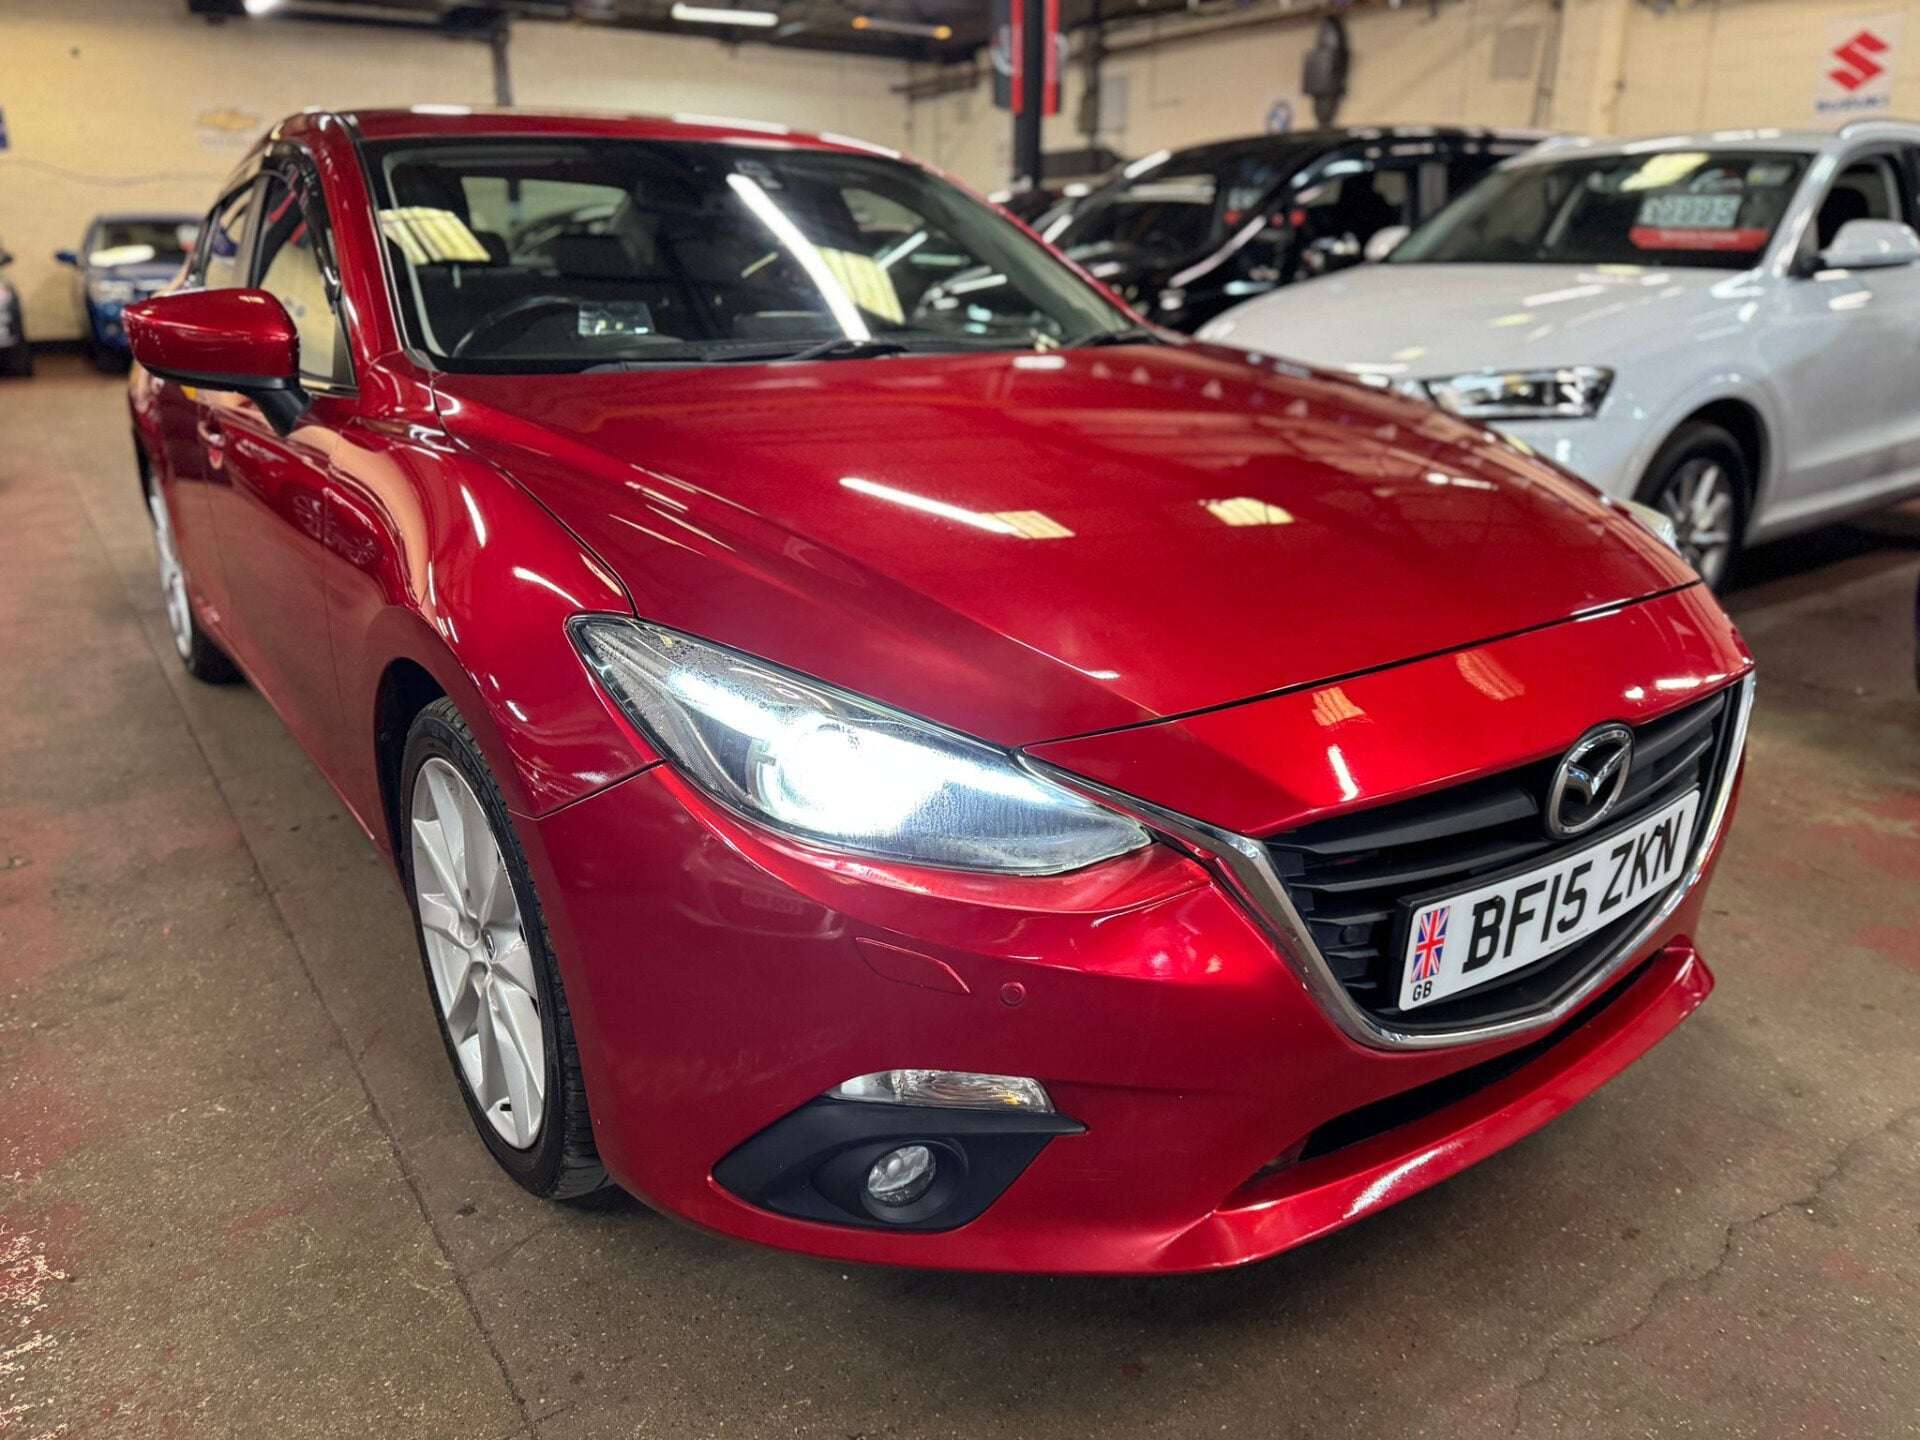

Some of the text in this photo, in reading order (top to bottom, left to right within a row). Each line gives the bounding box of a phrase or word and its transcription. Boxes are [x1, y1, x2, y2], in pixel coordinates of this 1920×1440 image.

[1462, 810, 1684, 974] BF15 ZKN
[1413, 981, 1432, 1002] GB
